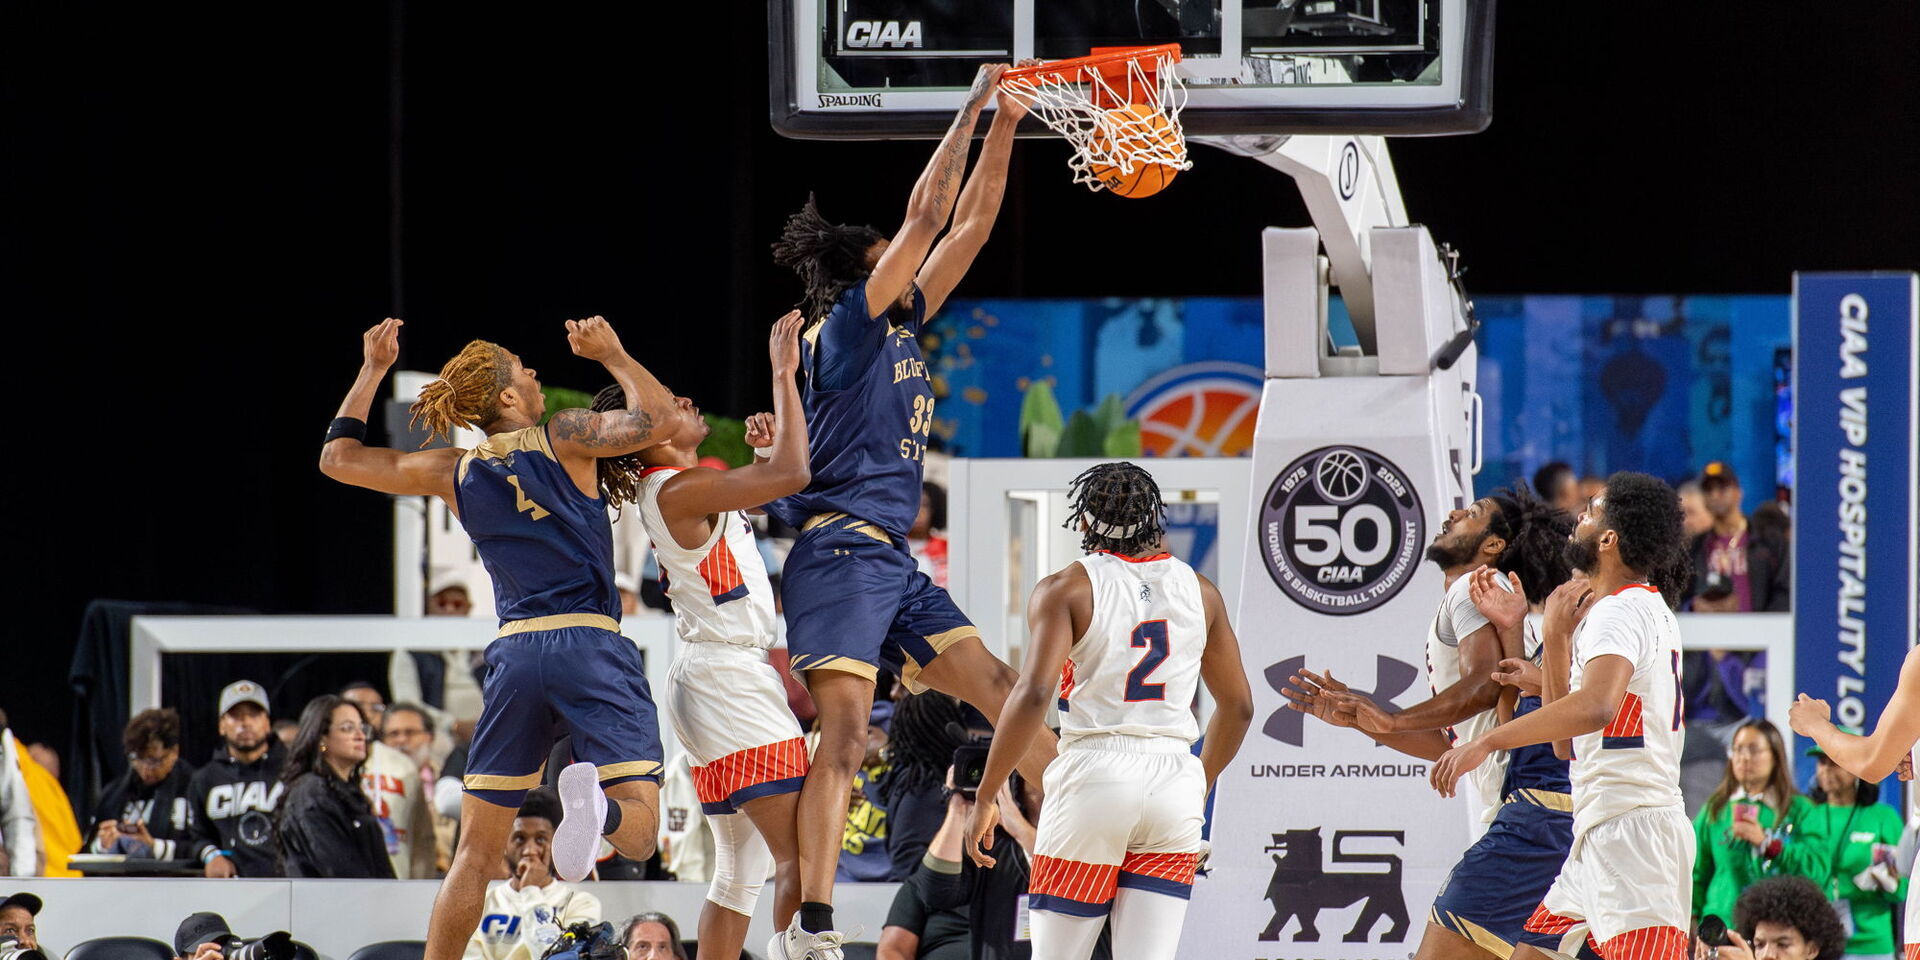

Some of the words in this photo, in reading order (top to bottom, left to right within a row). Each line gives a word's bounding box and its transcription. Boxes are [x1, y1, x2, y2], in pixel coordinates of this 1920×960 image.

[846, 21, 922, 48] CIAA
[818, 93, 882, 108] SPALDING
[1839, 293, 1869, 379] CIAA
[1839, 386, 1868, 447] VIP
[1281, 467, 1308, 493] 1975
[1376, 467, 1407, 498] 2025
[1293, 503, 1393, 566] 50
[1268, 521, 1292, 581] WOMEN'S
[1291, 577, 1369, 607] BASKETBALL
[1369, 520, 1416, 599] TOURNAMENT
[1317, 566, 1364, 583] CIAA
[1837, 448, 1867, 676] HOSPITALITY
[1124, 619, 1170, 702] 2
[1251, 764, 1325, 777] UNDER
[1330, 764, 1427, 777] ARMOUR
